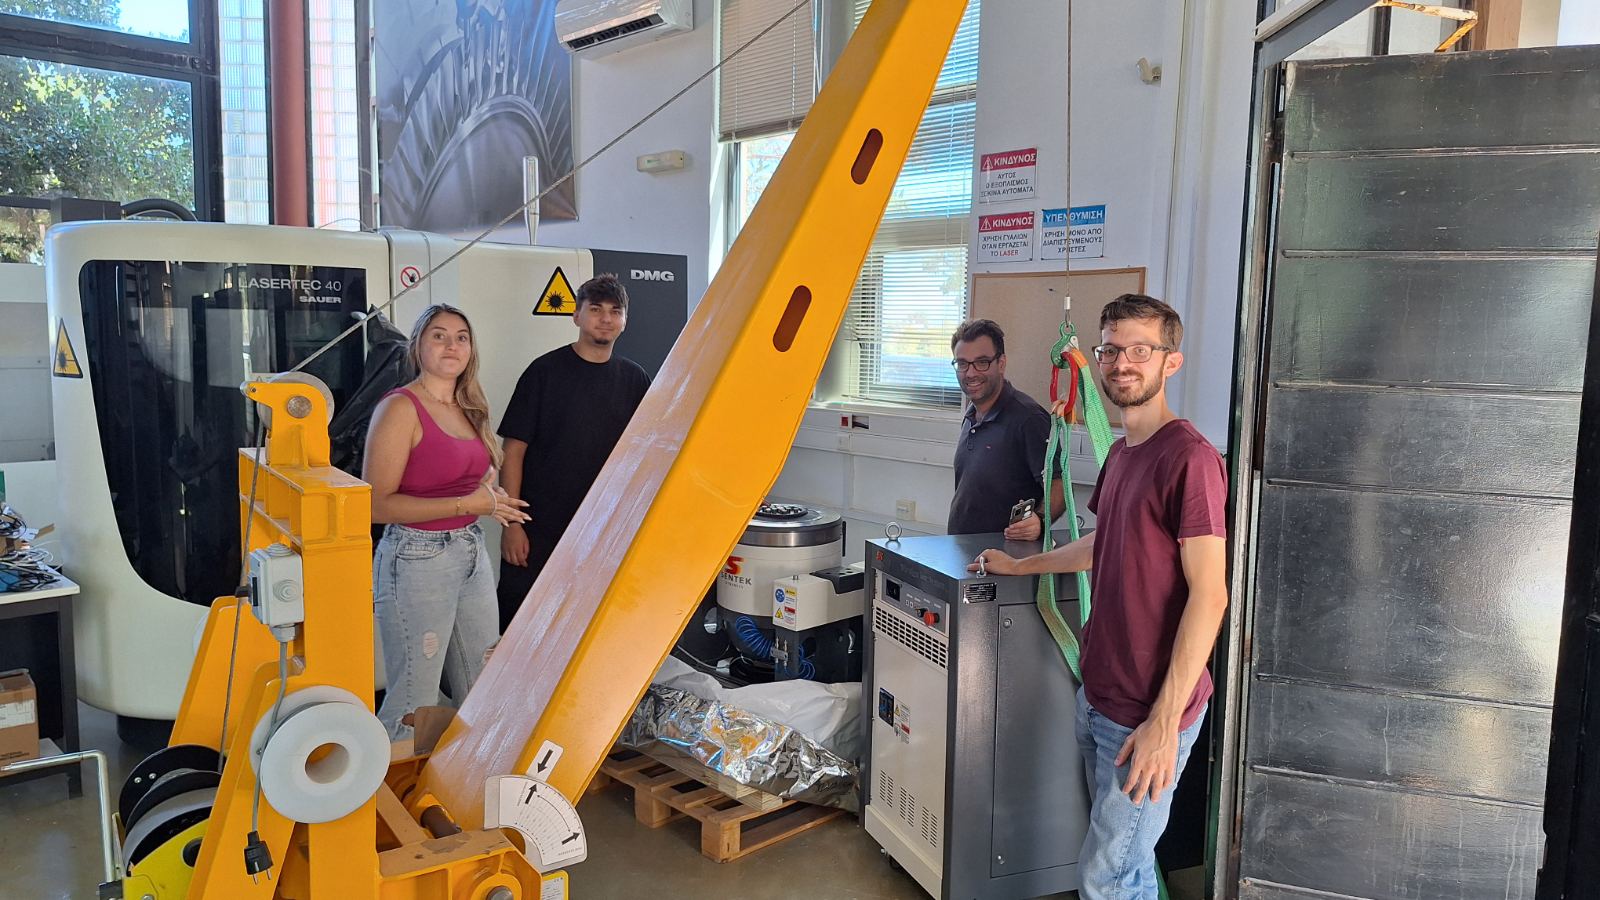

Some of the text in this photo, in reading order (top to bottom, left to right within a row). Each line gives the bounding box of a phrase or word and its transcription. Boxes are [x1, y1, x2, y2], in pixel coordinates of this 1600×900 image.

[994, 153, 1036, 166] ΚΙΝΔΥΝΟΣ
[1002, 186, 1034, 196] ΑΥΤΟΜΑΤΑ
[992, 216, 1033, 228] ΚΙΝΔΥΝΟΣ
[1044, 230, 1065, 238] ΧΡΗΣΗ
[998, 241, 1029, 249] ΕΡΓΑΖΕΤΑΙ
[630, 269, 675, 282] DMG
[238, 277, 342, 291] LASERTEC 40
[299, 295, 342, 304] SAUER
